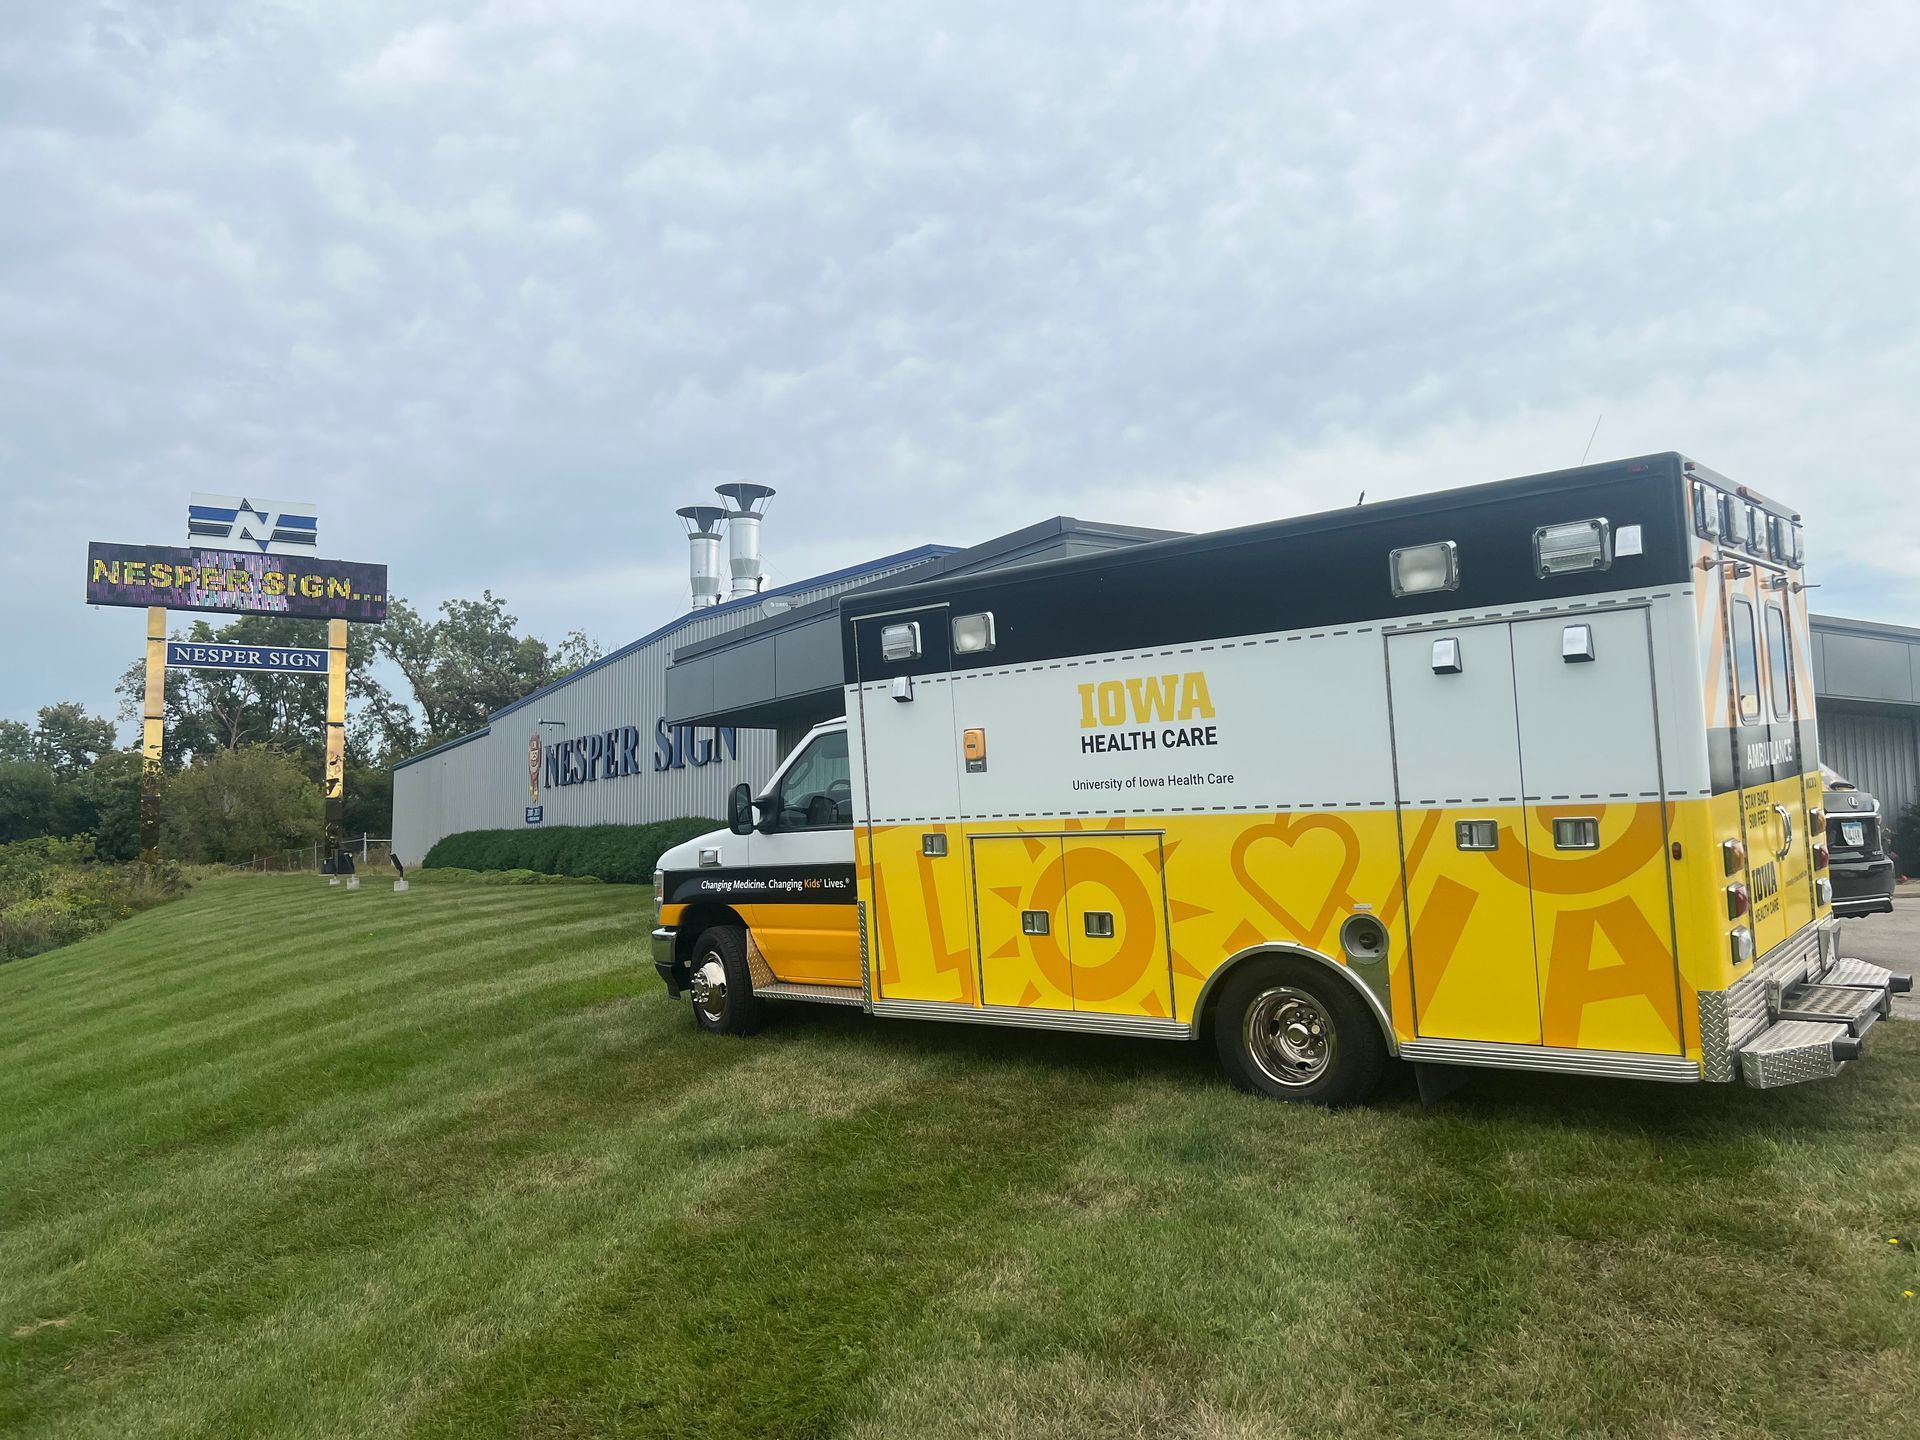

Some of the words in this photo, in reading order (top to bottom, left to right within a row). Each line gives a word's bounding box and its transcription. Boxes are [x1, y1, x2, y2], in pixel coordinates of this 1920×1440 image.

[92, 559, 251, 593] NESPER
[175, 647, 262, 666] NESPER
[269, 653, 321, 668] SIGN
[1077, 671, 1216, 728] IOWA
[544, 725, 640, 789] NESPER
[655, 716, 736, 772] SIGN
[1081, 730, 1156, 754] HEALTH
[1162, 726, 1218, 748] CARE
[1747, 739, 1793, 770] AMBULANCE
[1072, 778, 1122, 791] University
[1125, 777, 1136, 788] of
[1139, 777, 1165, 788] Iowa
[1168, 773, 1204, 786] Health
[1207, 773, 1234, 784] Care
[1744, 794, 1757, 810] STAY
[1757, 790, 1769, 806] BACK
[701, 880, 733, 892] Changing
[732, 880, 767, 889] Medicine.
[768, 879, 803, 892] Changing
[1751, 861, 1778, 904] IOWA
